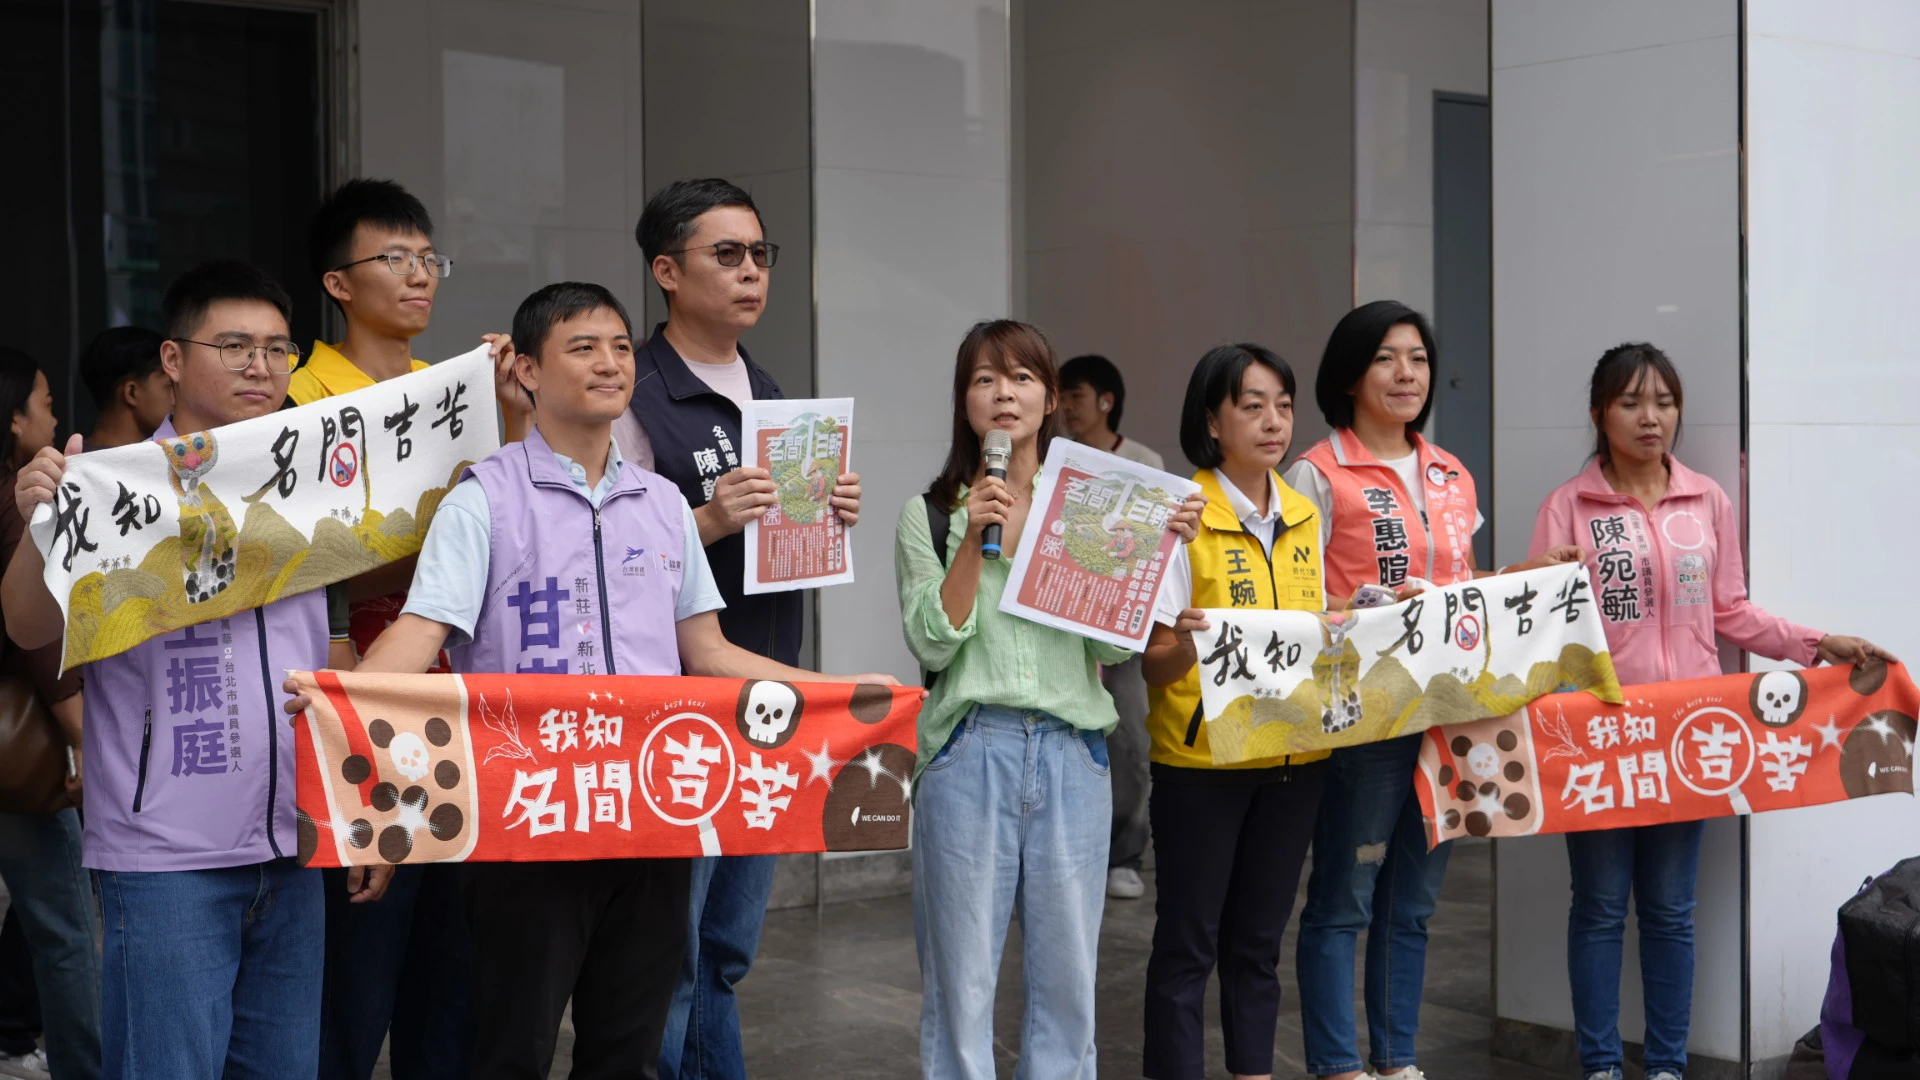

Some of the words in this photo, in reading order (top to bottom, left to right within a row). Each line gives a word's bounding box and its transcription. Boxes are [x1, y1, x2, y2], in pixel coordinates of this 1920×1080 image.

[712, 425, 741, 473] 名間鄉
[49, 482, 162, 573] 我知
[1225, 549, 1257, 607] 王婉
[1591, 516, 1640, 621] 陳宛毓
[575, 577, 591, 614] 新莊
[577, 641, 595, 675] 新北
[1201, 620, 1302, 687] 我知
[224, 662, 243, 772] 台北市議員參選人
[538, 707, 623, 752] 我知
[1586, 712, 1656, 750] 我知
